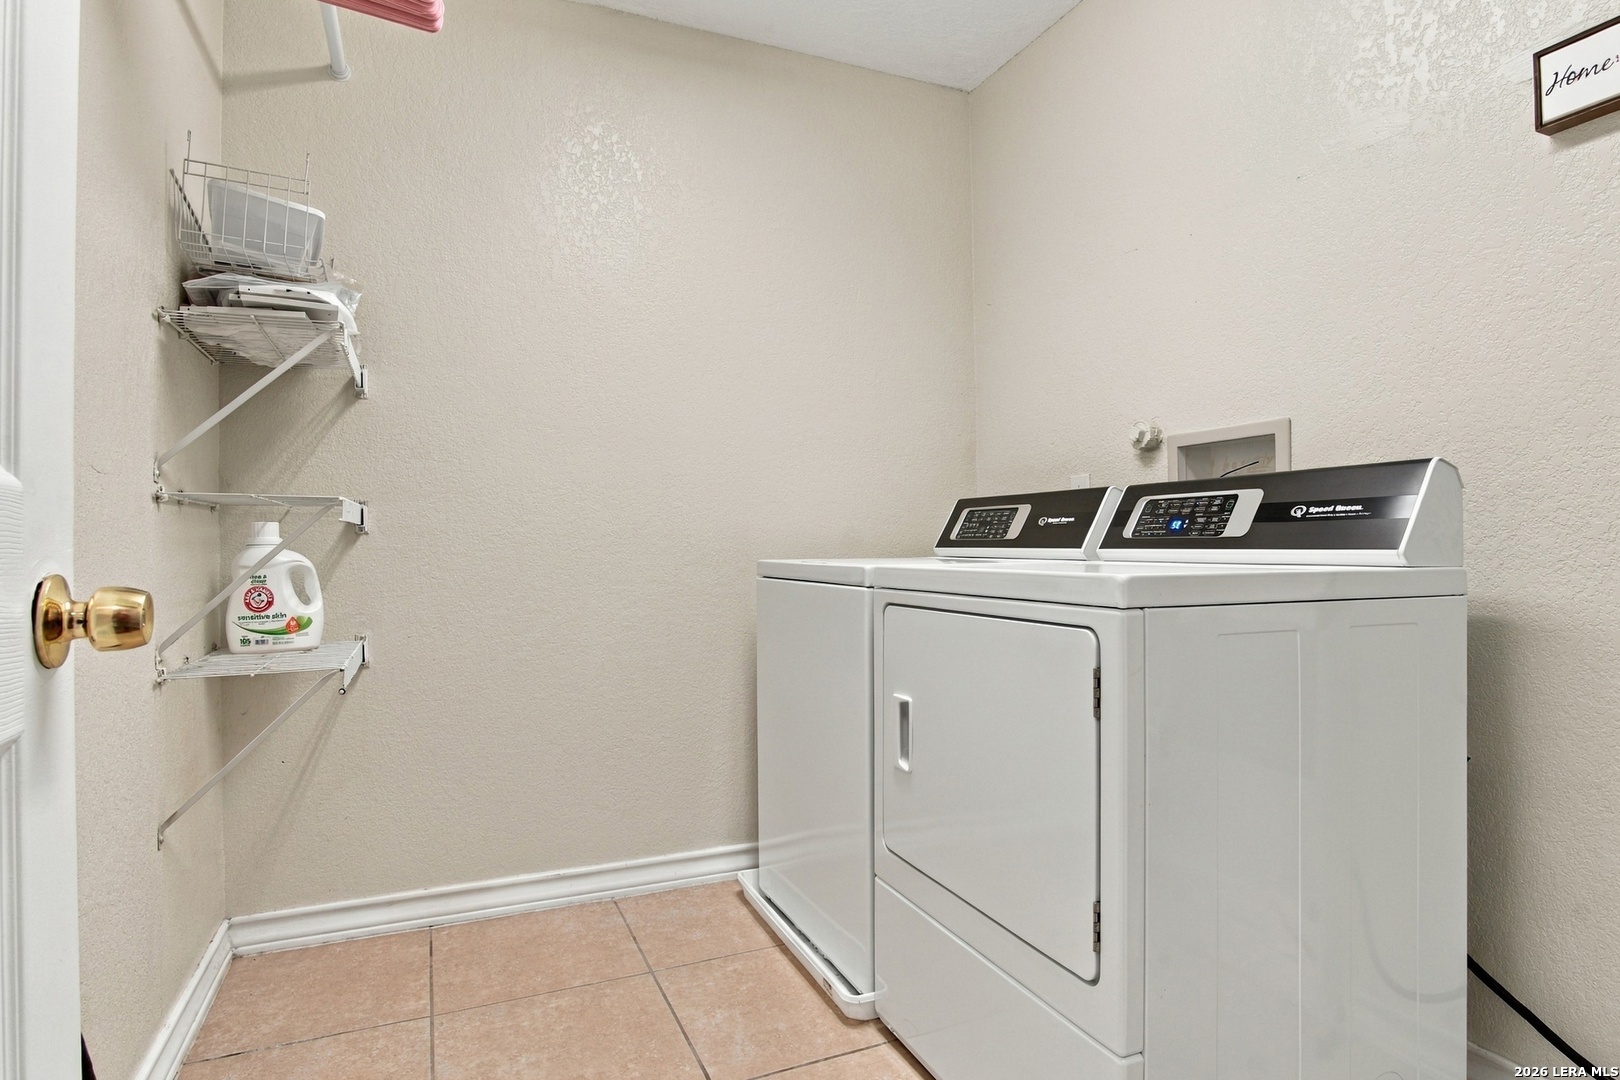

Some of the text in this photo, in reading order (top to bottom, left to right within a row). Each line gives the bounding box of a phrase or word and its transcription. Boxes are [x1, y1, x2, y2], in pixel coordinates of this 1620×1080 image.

[1545, 58, 1615, 96] Home
[1308, 505, 1335, 514] Speed
[271, 612, 287, 620] skin
